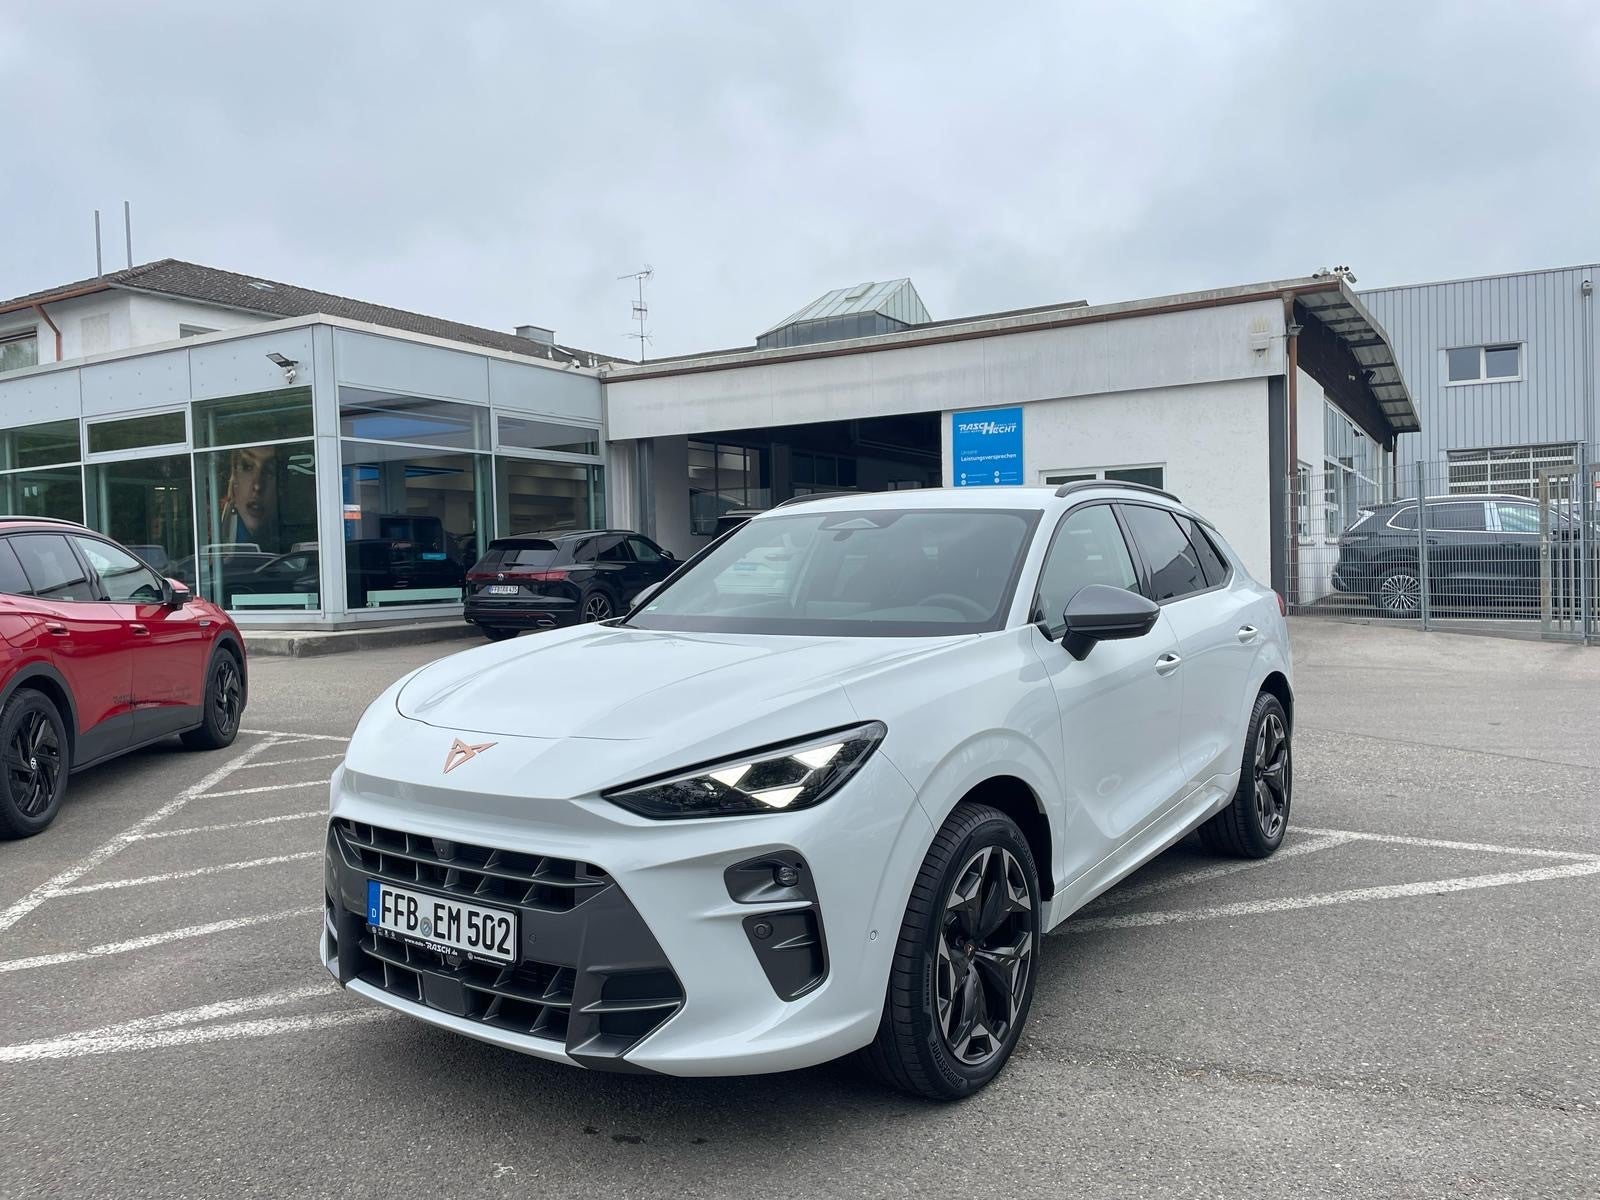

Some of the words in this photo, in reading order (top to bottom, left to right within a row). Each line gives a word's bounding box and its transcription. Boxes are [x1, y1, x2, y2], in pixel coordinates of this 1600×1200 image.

[960, 453, 1017, 462] Leistungsversprechen
[371, 908, 377, 918] D
[381, 889, 419, 931] FFB
[467, 910, 511, 955] 502
